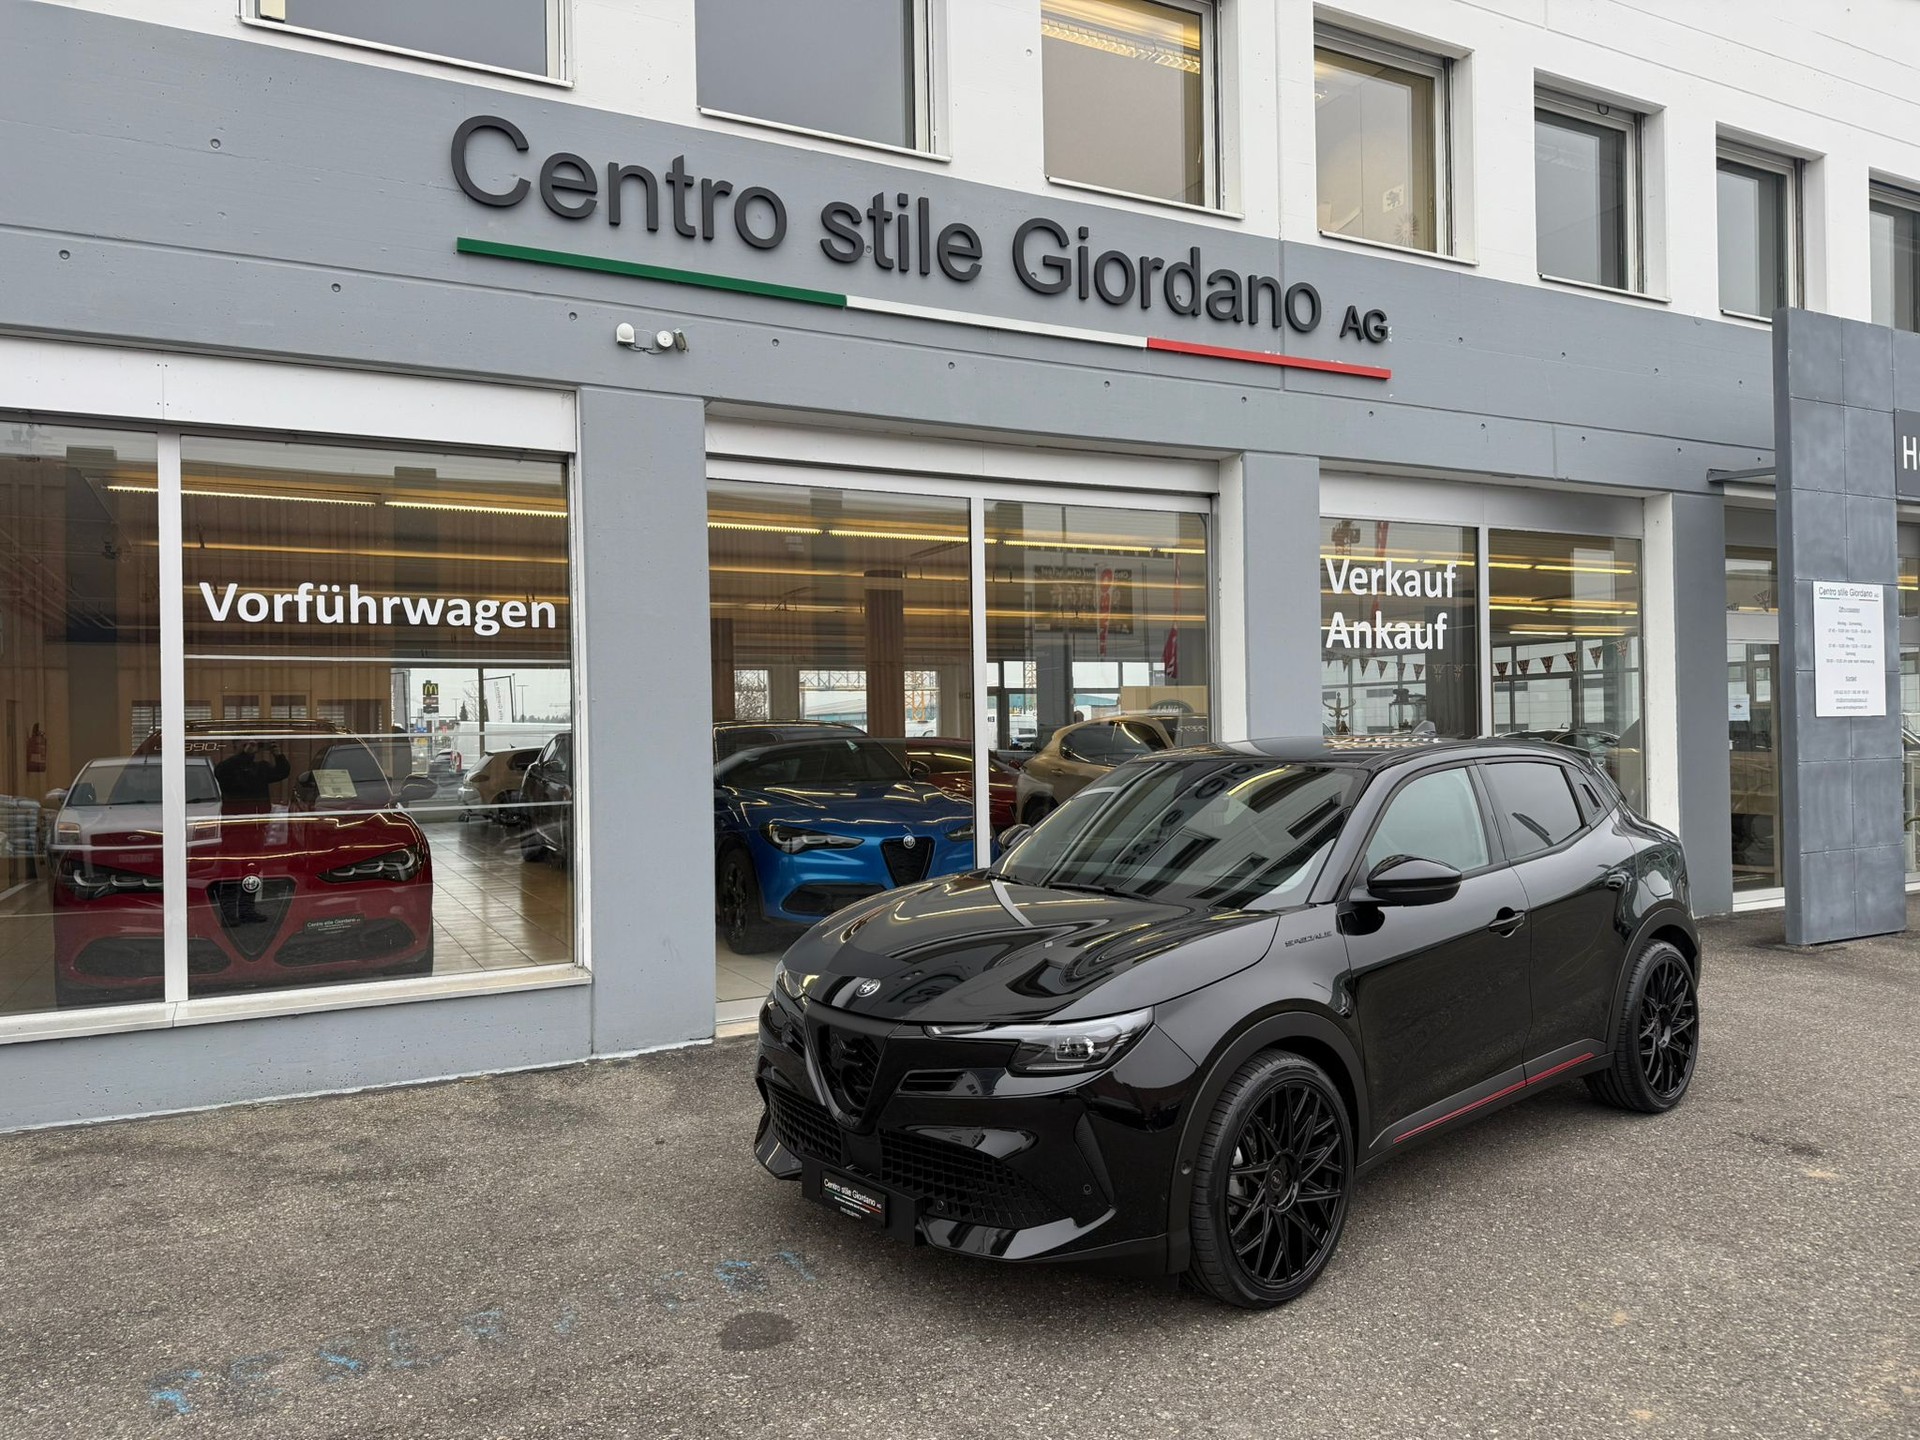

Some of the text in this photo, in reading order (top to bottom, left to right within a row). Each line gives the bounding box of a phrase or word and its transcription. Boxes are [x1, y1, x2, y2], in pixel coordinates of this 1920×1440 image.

[450, 114, 1389, 343] Centro stile Giordano AG
[1325, 558, 1457, 598] Verkauf
[1818, 586, 1837, 597] Centro
[1838, 588, 1848, 596] stile
[1849, 588, 1874, 598] Giordano
[199, 582, 556, 636] Vorführwagen
[1325, 610, 1448, 650] Ankauf
[1157, 704, 1179, 714] LAND
[824, 1178, 840, 1192] Centro
[852, 1190, 876, 1206] Giordano
